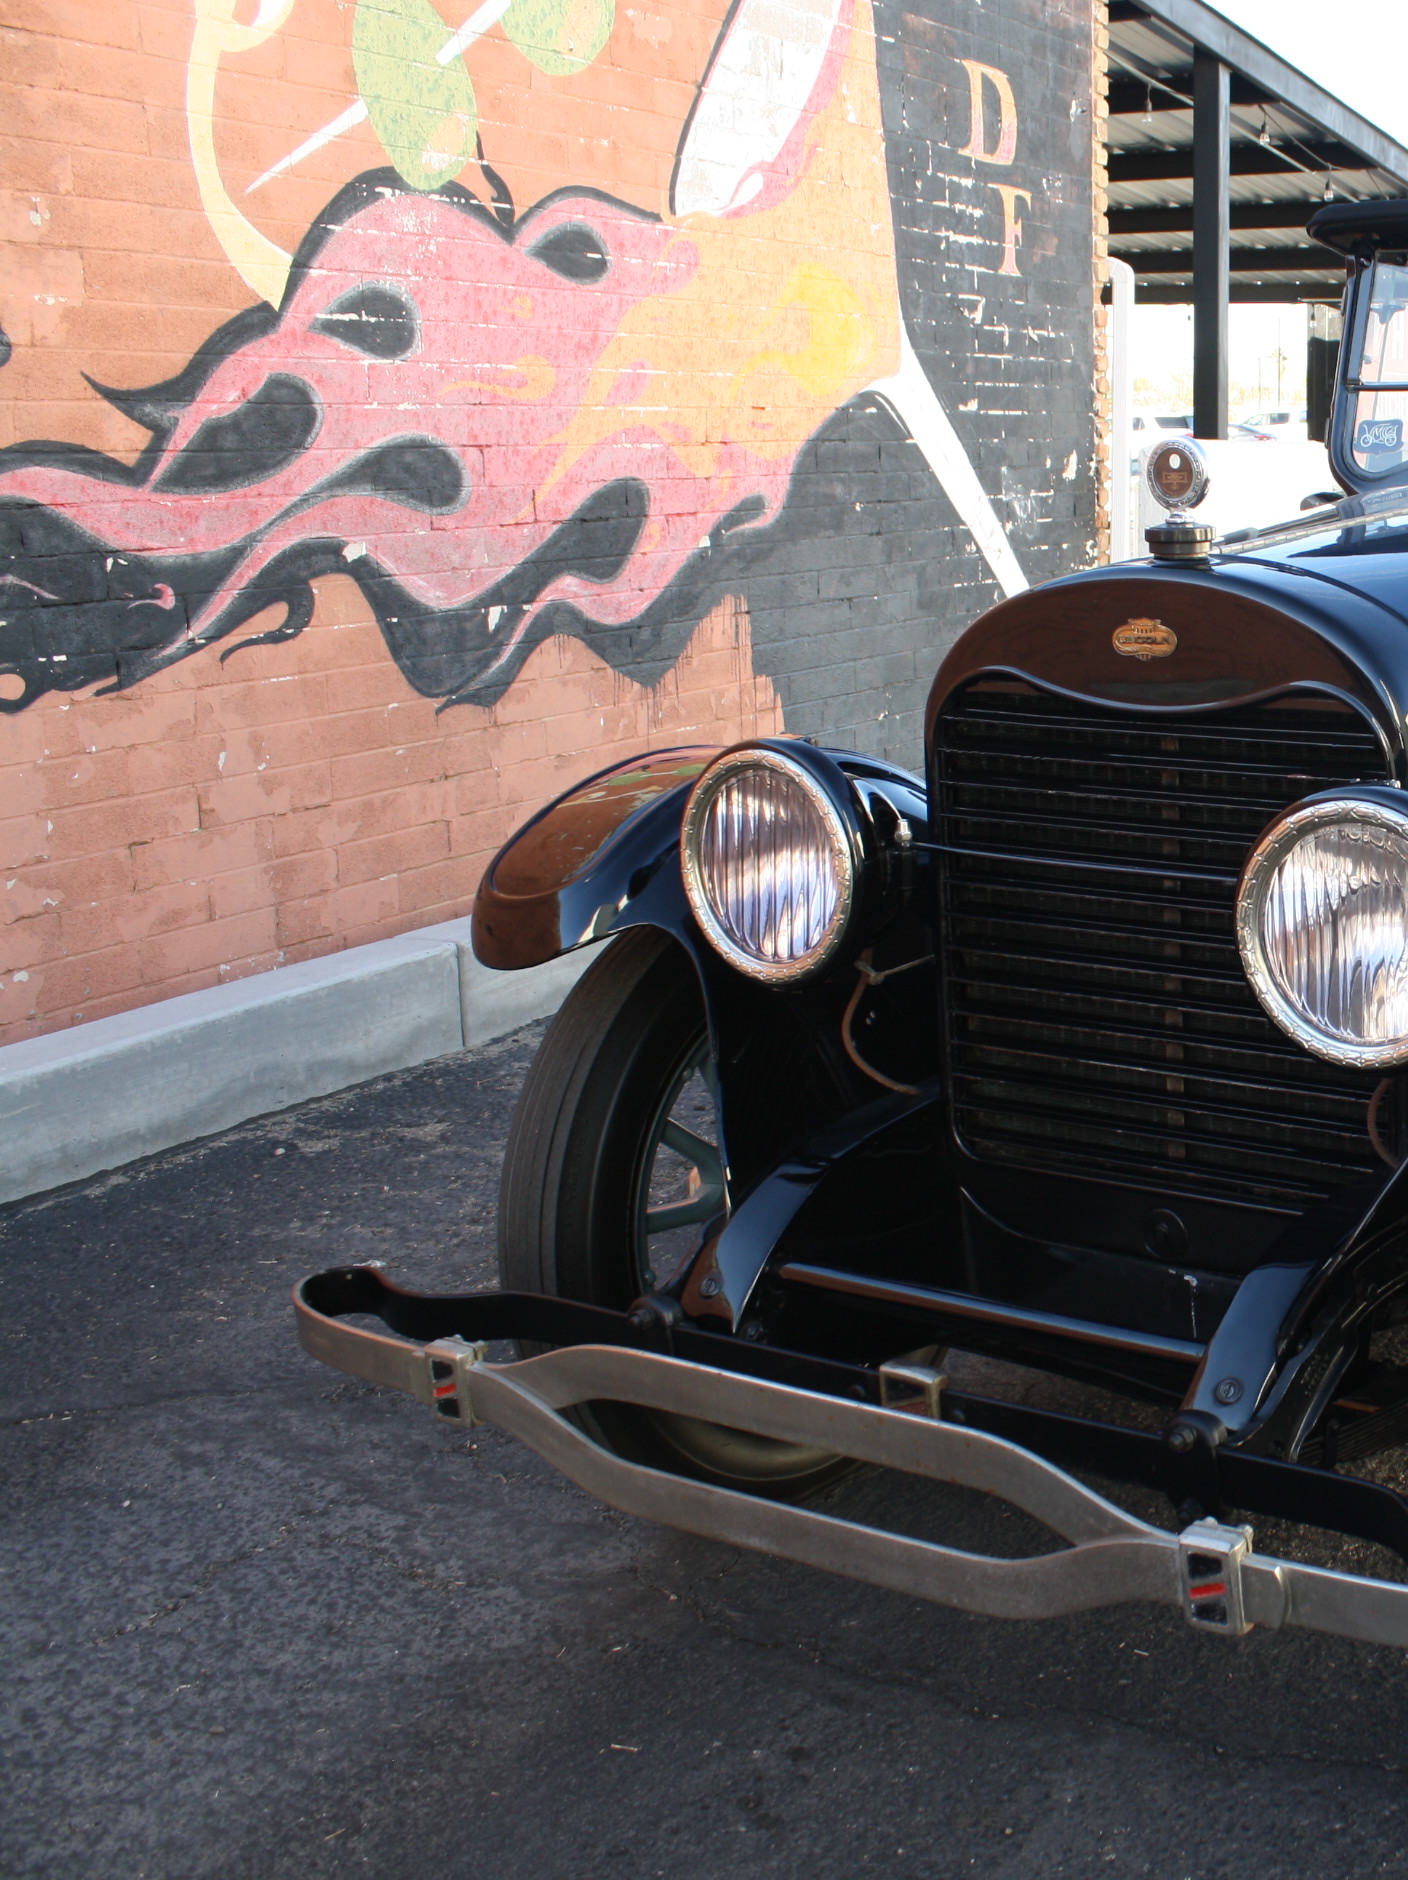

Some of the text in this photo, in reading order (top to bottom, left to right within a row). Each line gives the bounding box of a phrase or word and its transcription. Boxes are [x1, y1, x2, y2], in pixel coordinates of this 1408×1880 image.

[957, 58, 1018, 166] D
[997, 183, 1033, 277] F
[1118, 634, 1170, 645] LINCOLN
